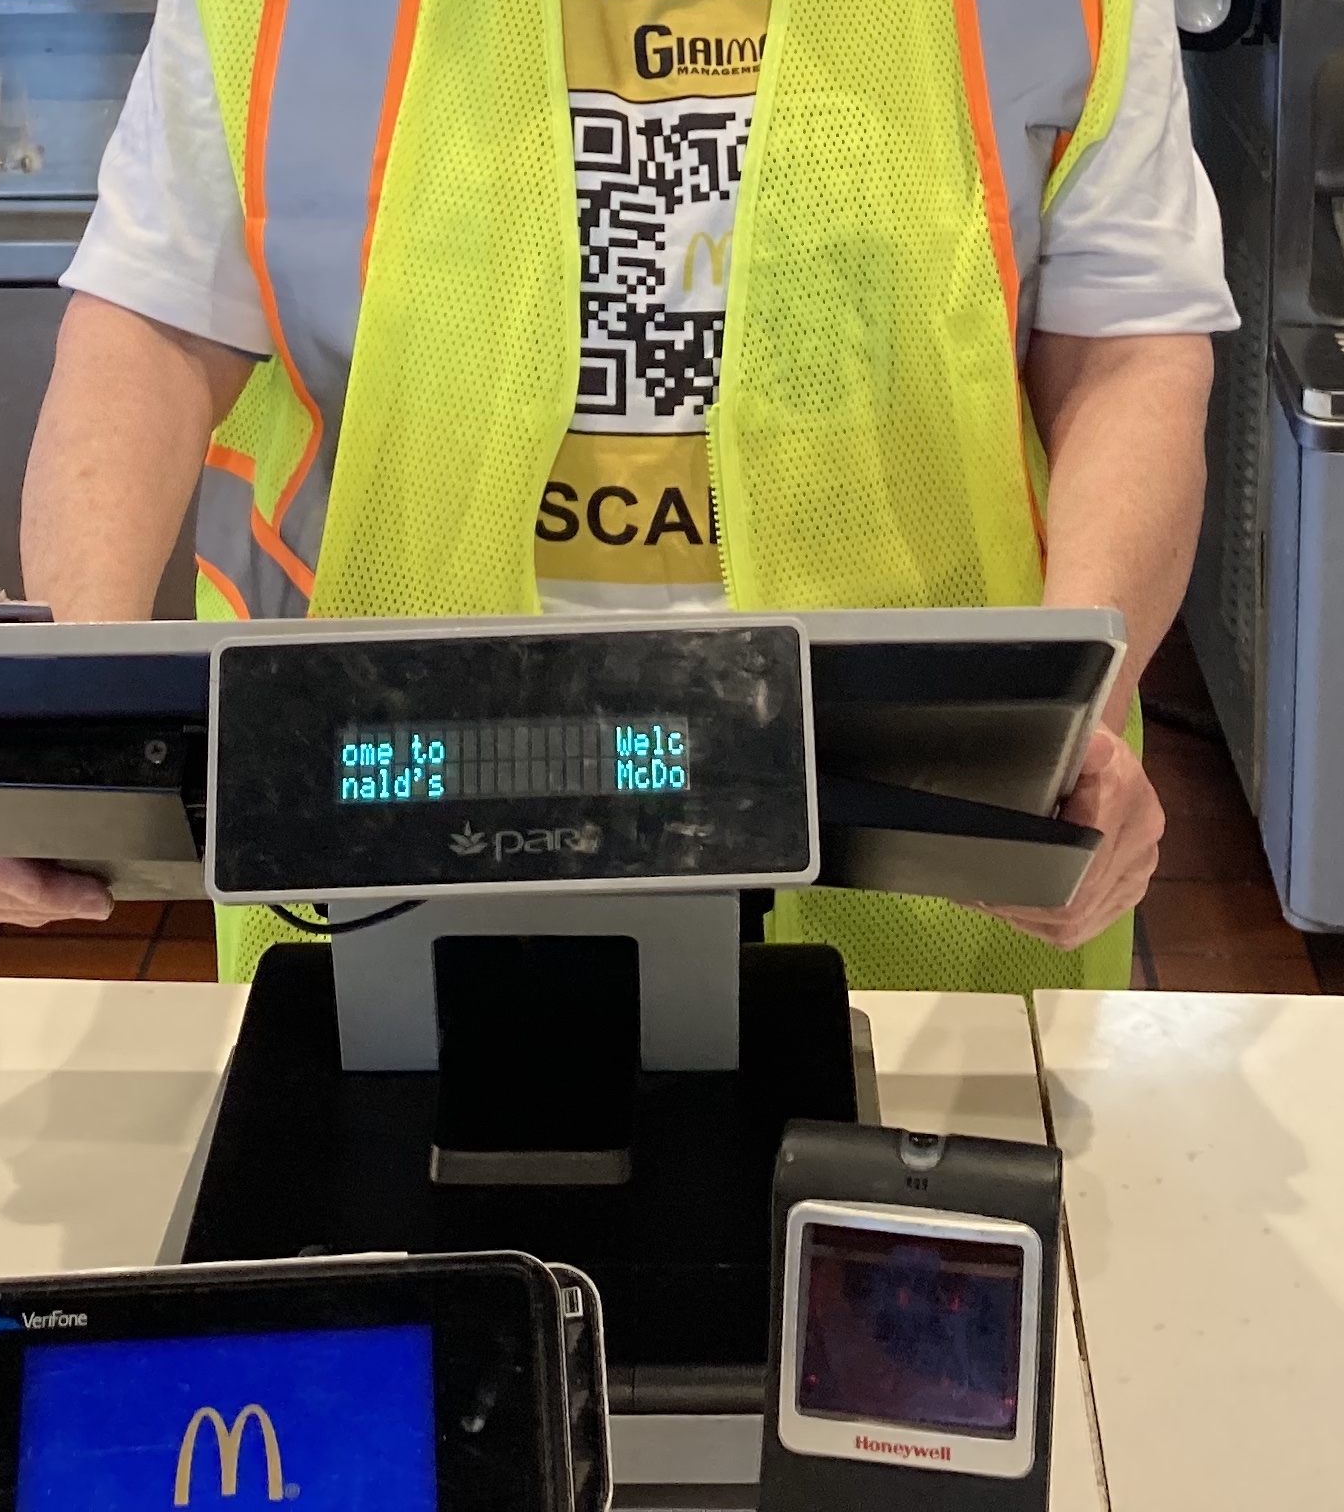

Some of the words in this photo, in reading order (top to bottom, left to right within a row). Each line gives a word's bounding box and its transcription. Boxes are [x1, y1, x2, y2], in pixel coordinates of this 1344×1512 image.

[677, 65, 761, 76] MANAGEME
[342, 741, 394, 767] ome
[412, 734, 445, 764] to
[615, 725, 685, 757] Welc
[342, 767, 445, 800] nald's
[616, 759, 685, 790] McDo
[22, 1310, 87, 1329] VeriFone
[856, 1435, 951, 1462] Honeywell
